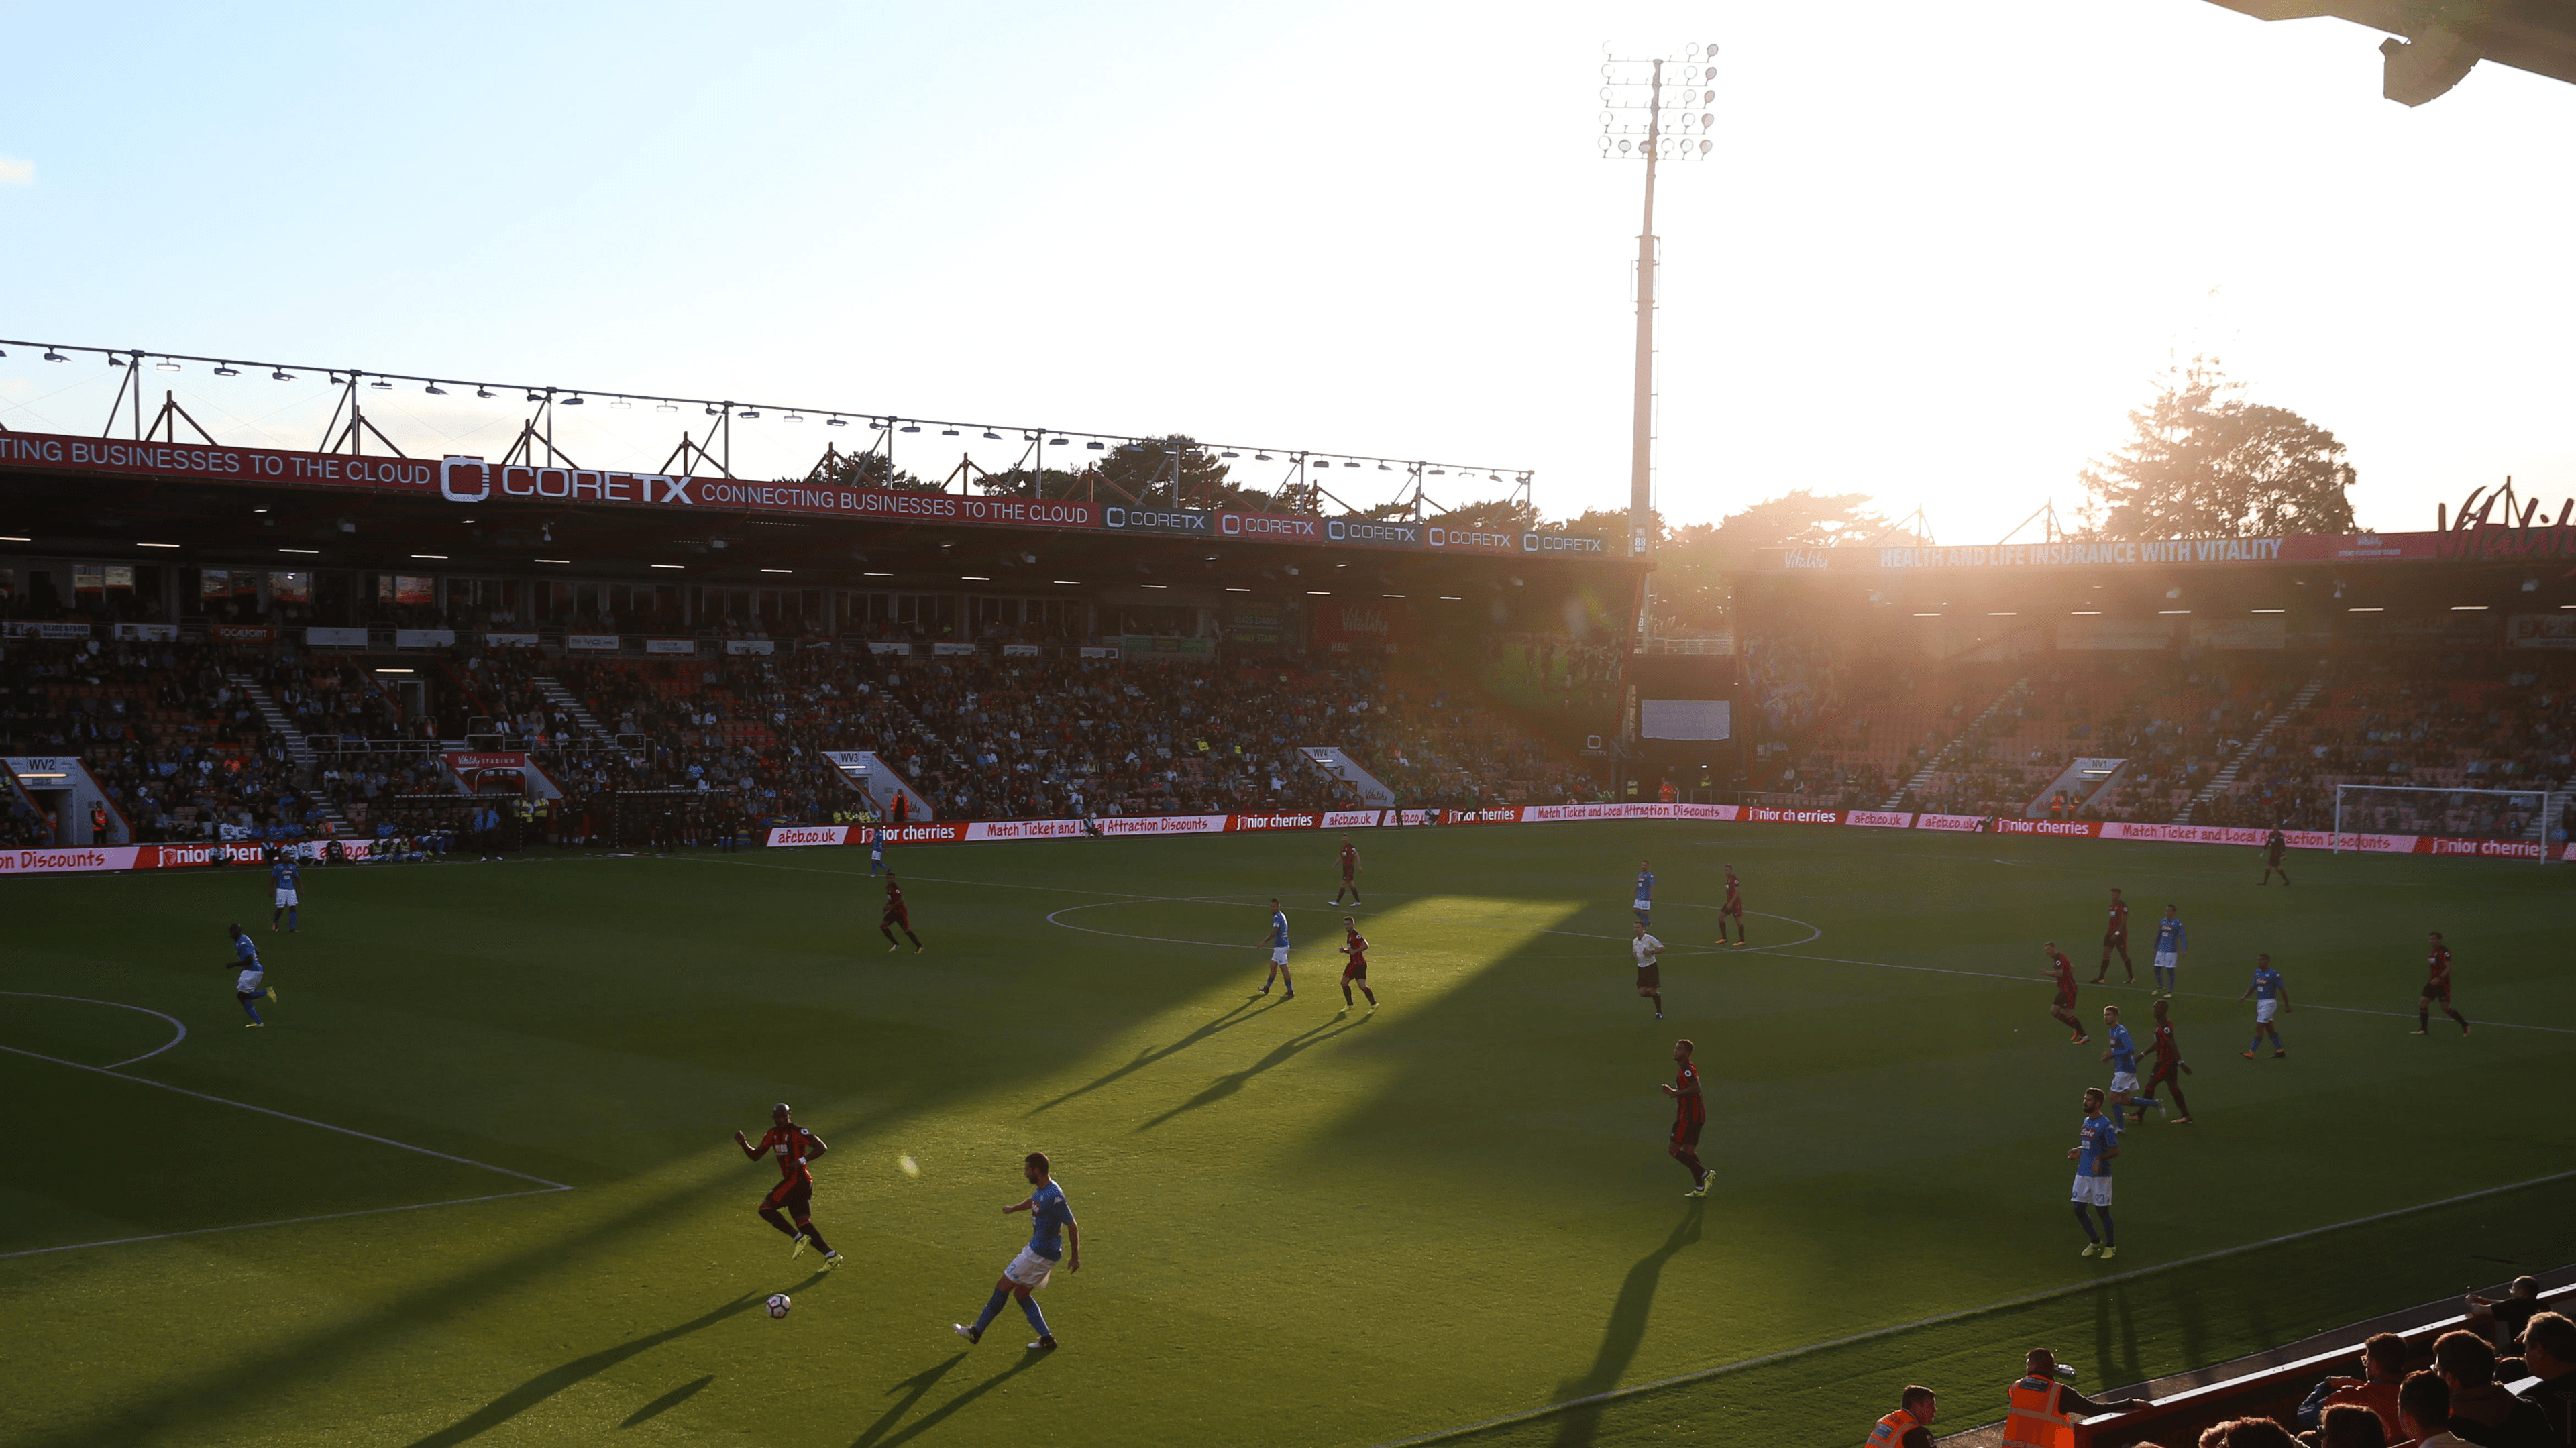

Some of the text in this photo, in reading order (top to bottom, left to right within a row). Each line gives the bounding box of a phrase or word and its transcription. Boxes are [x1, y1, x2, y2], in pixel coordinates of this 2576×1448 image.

[72, 441, 240, 473] BUSINESSES
[250, 454, 283, 476] TO
[290, 457, 339, 479] THE
[346, 461, 431, 484] CLOUD
[502, 466, 693, 504] CORETX
[702, 484, 1088, 524] CONNECTING BUSINESSES TO THE CLOUD
[1130, 511, 1205, 529] CORETX
[1245, 518, 1315, 535] CORETX
[1350, 524, 1416, 542] CORETX
[1450, 530, 1511, 547] CORETX
[1544, 536, 1601, 551] CORETX
[1784, 548, 1828, 571] Vitality
[1880, 537, 2283, 568] HEALTH AND LIFE INSURANCE WITH VITALITY
[458, 755, 480, 766] Vitality
[841, 753, 859, 763] WV3
[1313, 749, 1328, 757] WV4
[29, 759, 55, 771] WV2
[2092, 759, 2107, 768] NV1
[1365, 788, 1387, 803] Vitality
[1329, 812, 1371, 826] afcb.co.uk
[1538, 803, 1721, 819] Match Ticket and Local Attraction Discounts
[1782, 807, 1836, 822] cherries
[987, 823, 1020, 837] Match
[1022, 821, 1055, 836] Ticket
[1058, 820, 1076, 835] and
[1108, 817, 1159, 833] Attraction
[1161, 817, 1208, 832] Discounts
[1270, 813, 1313, 828] cherries
[1854, 813, 1902, 826] afcb.co.uk
[778, 828, 836, 844] afcb.co.uk
[902, 824, 955, 841] cherries
[2037, 820, 2089, 836] cherries
[2123, 824, 2157, 838] Match
[2161, 825, 2198, 840] Ticket
[2201, 827, 2222, 840] and
[2226, 828, 2256, 842] Local
[20, 849, 105, 869] Discounts
